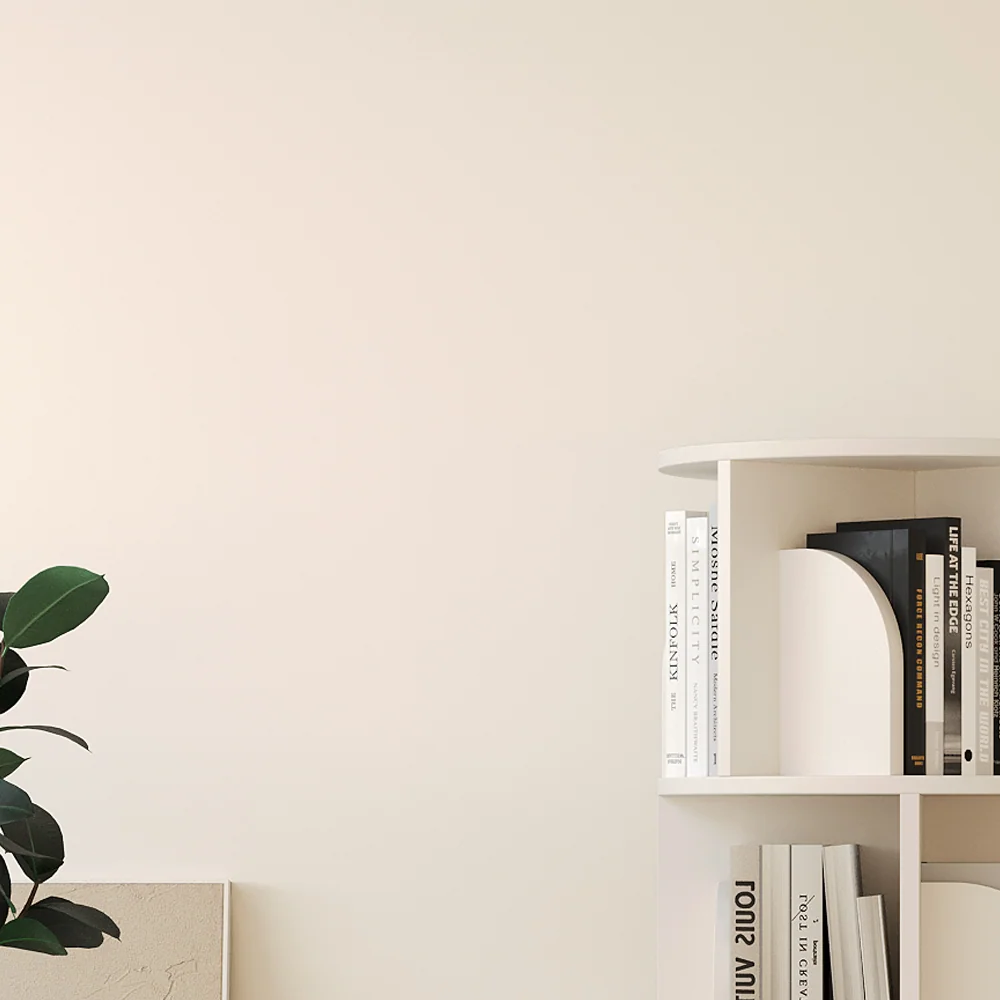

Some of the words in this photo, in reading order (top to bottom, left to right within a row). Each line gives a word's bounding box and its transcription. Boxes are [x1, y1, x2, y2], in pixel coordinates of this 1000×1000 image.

[949, 526, 958, 552] LIFE
[949, 555, 958, 571] AT
[692, 536, 700, 665] SIMPLICITY
[932, 577, 940, 607] Light
[949, 573, 958, 597] THE
[933, 611, 940, 623] in
[949, 600, 958, 633] EDGE
[964, 575, 974, 648] Hexagons
[669, 604, 678, 682] KINFOLK
[932, 626, 940, 667] design
